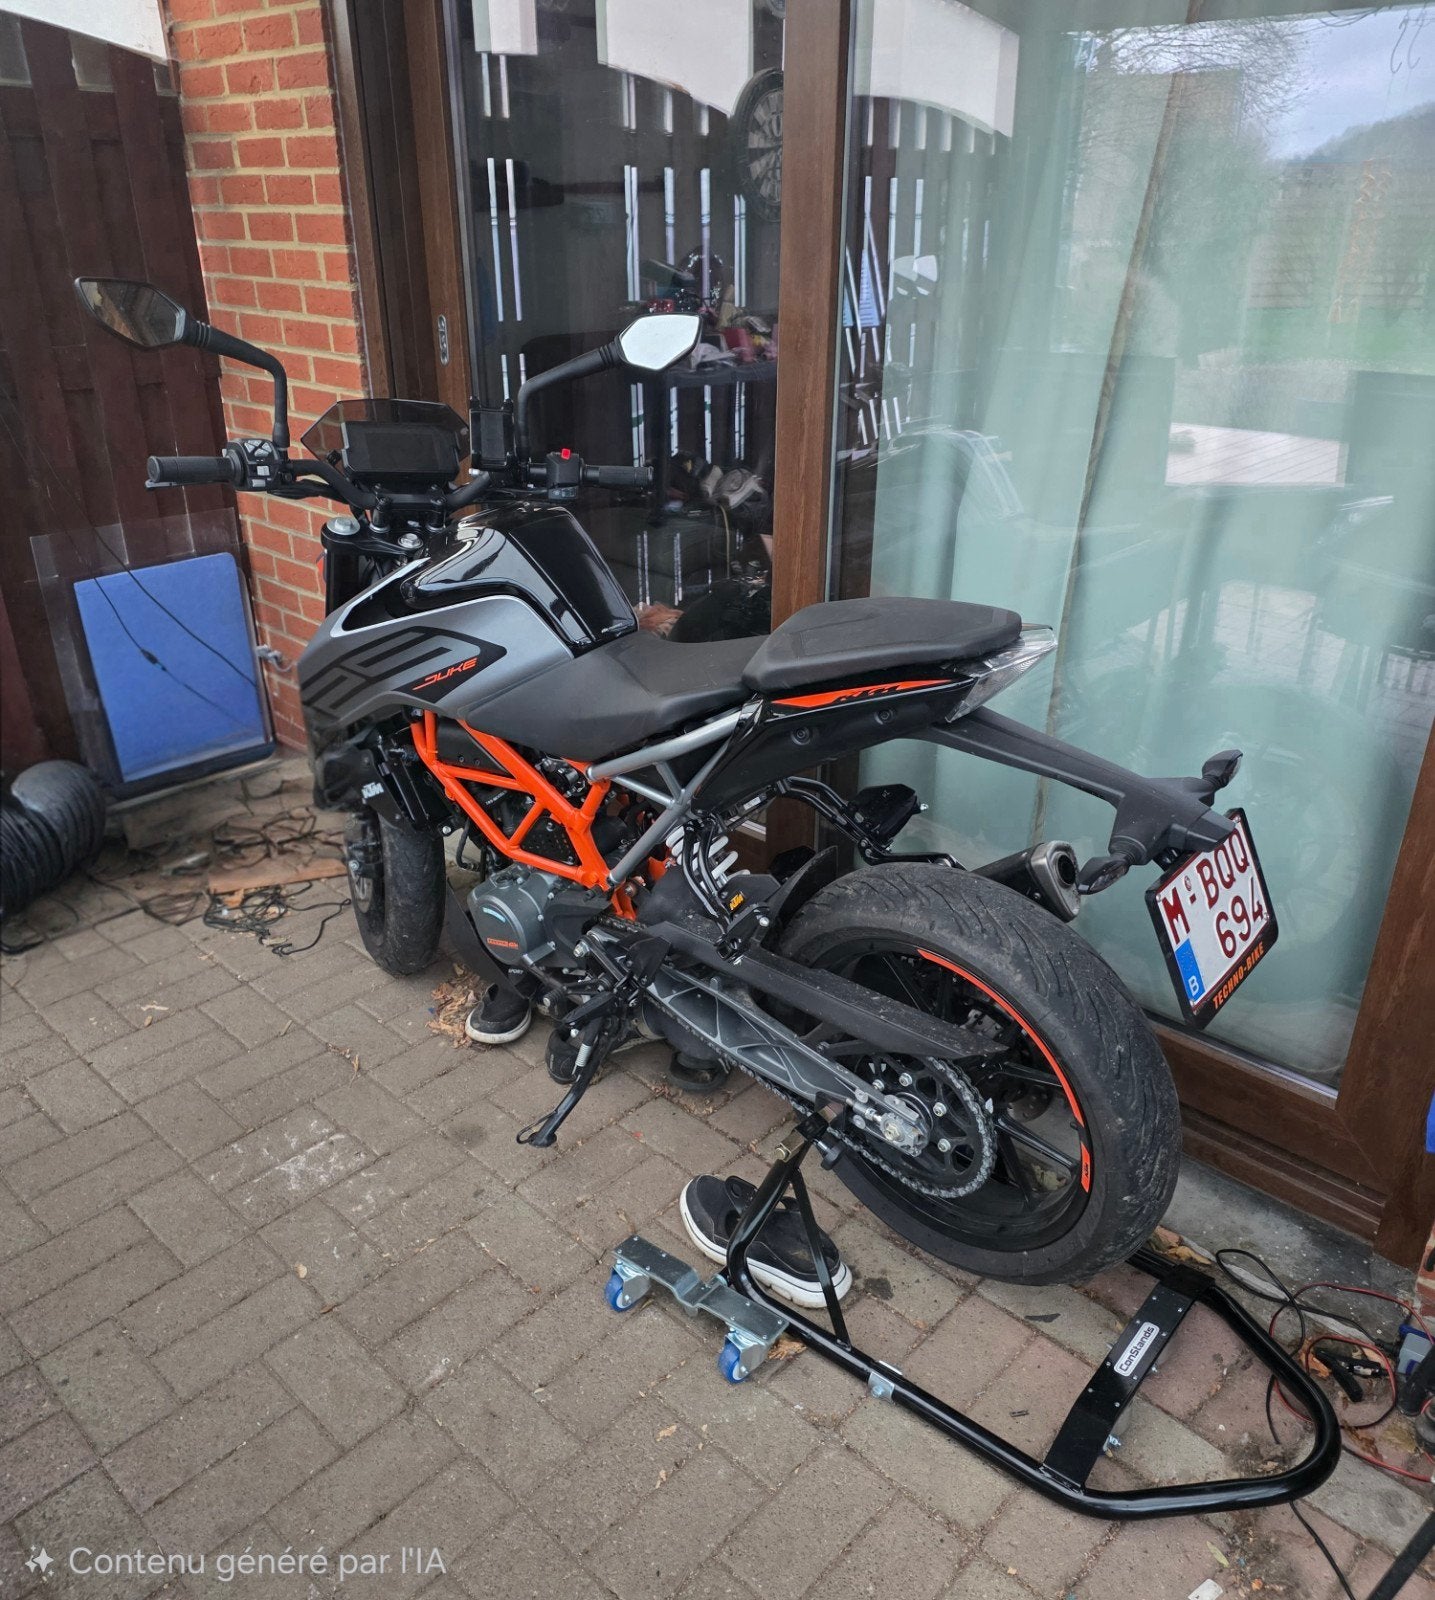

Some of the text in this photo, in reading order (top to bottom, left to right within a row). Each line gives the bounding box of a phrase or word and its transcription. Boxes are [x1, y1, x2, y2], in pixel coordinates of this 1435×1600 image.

[412, 657, 478, 691] DUKE
[1215, 876, 1263, 958] 694
[1188, 975, 1200, 997] B
[1213, 941, 1264, 1010] TECHNO-BIKE
[1119, 1326, 1155, 1372] ConStands
